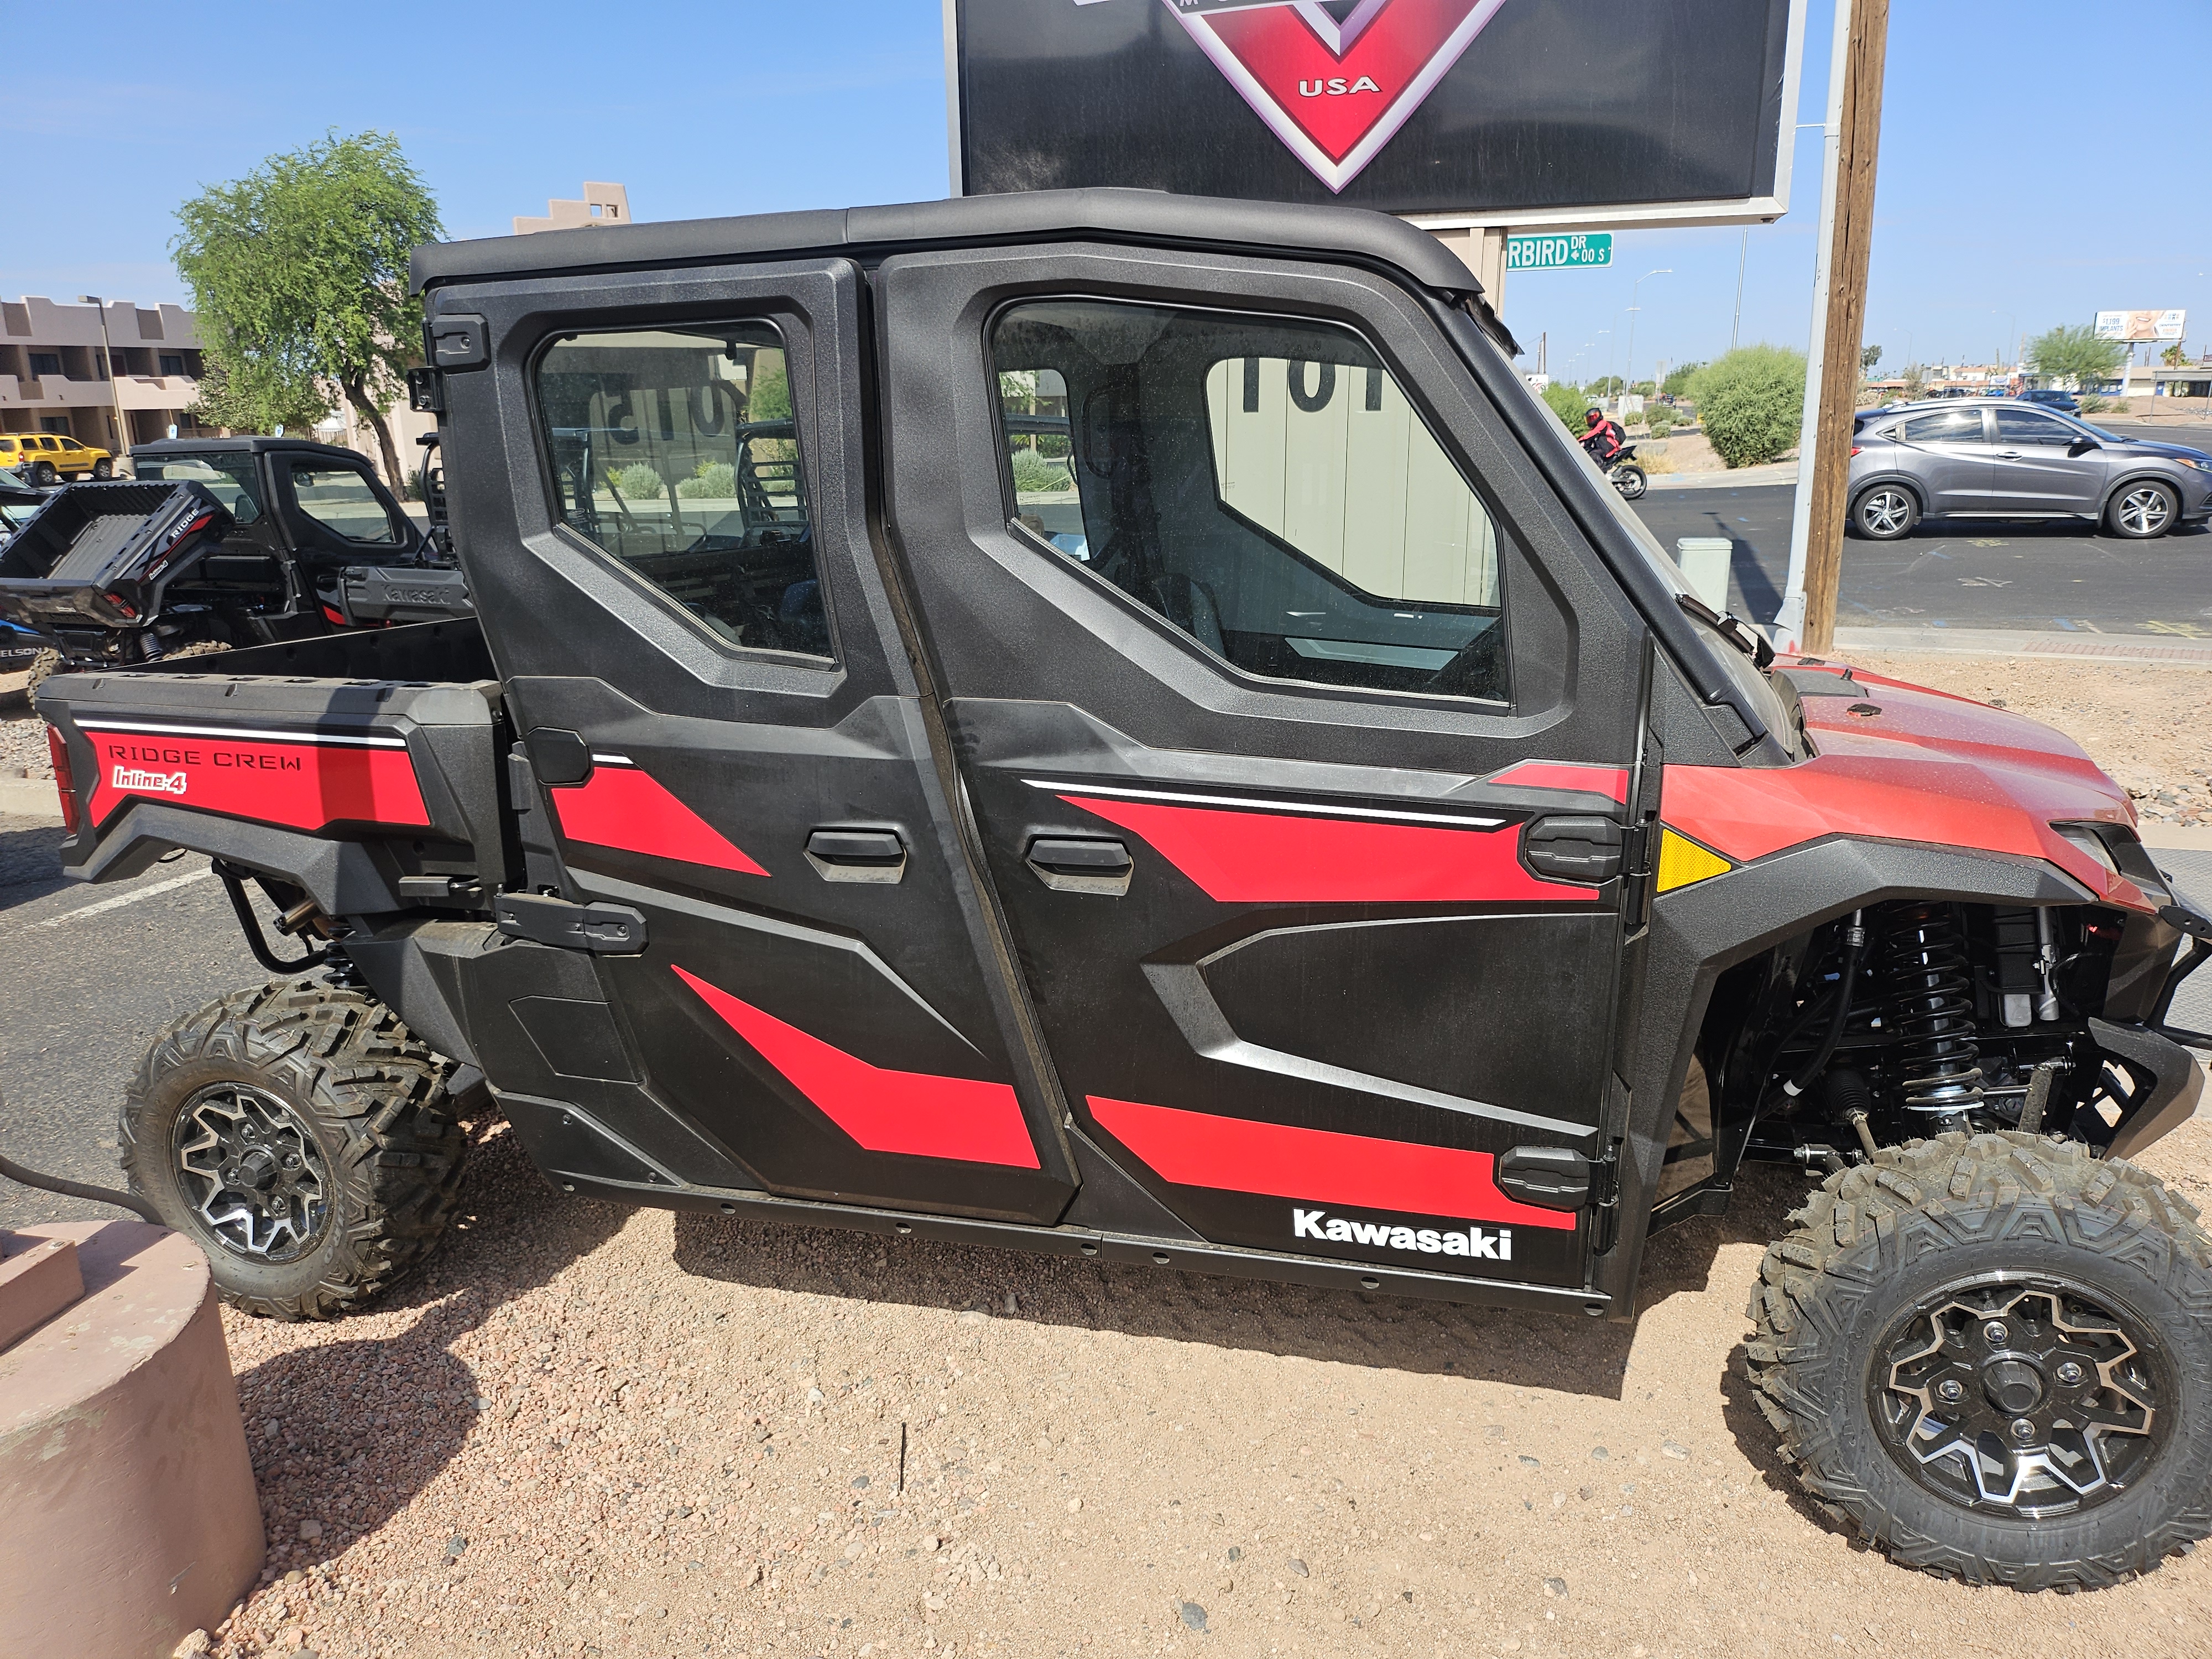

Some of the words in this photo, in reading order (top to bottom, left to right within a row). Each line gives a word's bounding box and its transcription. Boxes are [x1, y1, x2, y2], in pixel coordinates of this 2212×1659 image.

[1298, 76, 1381, 97] USA
[1508, 239, 1568, 267] RBIRD
[1571, 236, 1587, 249] DR
[1598, 248, 1604, 262] S
[171, 508, 200, 538] RIDGE
[380, 584, 451, 604] Kawasaki
[109, 745, 201, 765] RIDGE
[213, 752, 301, 771] CREW
[113, 766, 186, 794] Inline-4
[1293, 1208, 1512, 1260] Kawasaki
